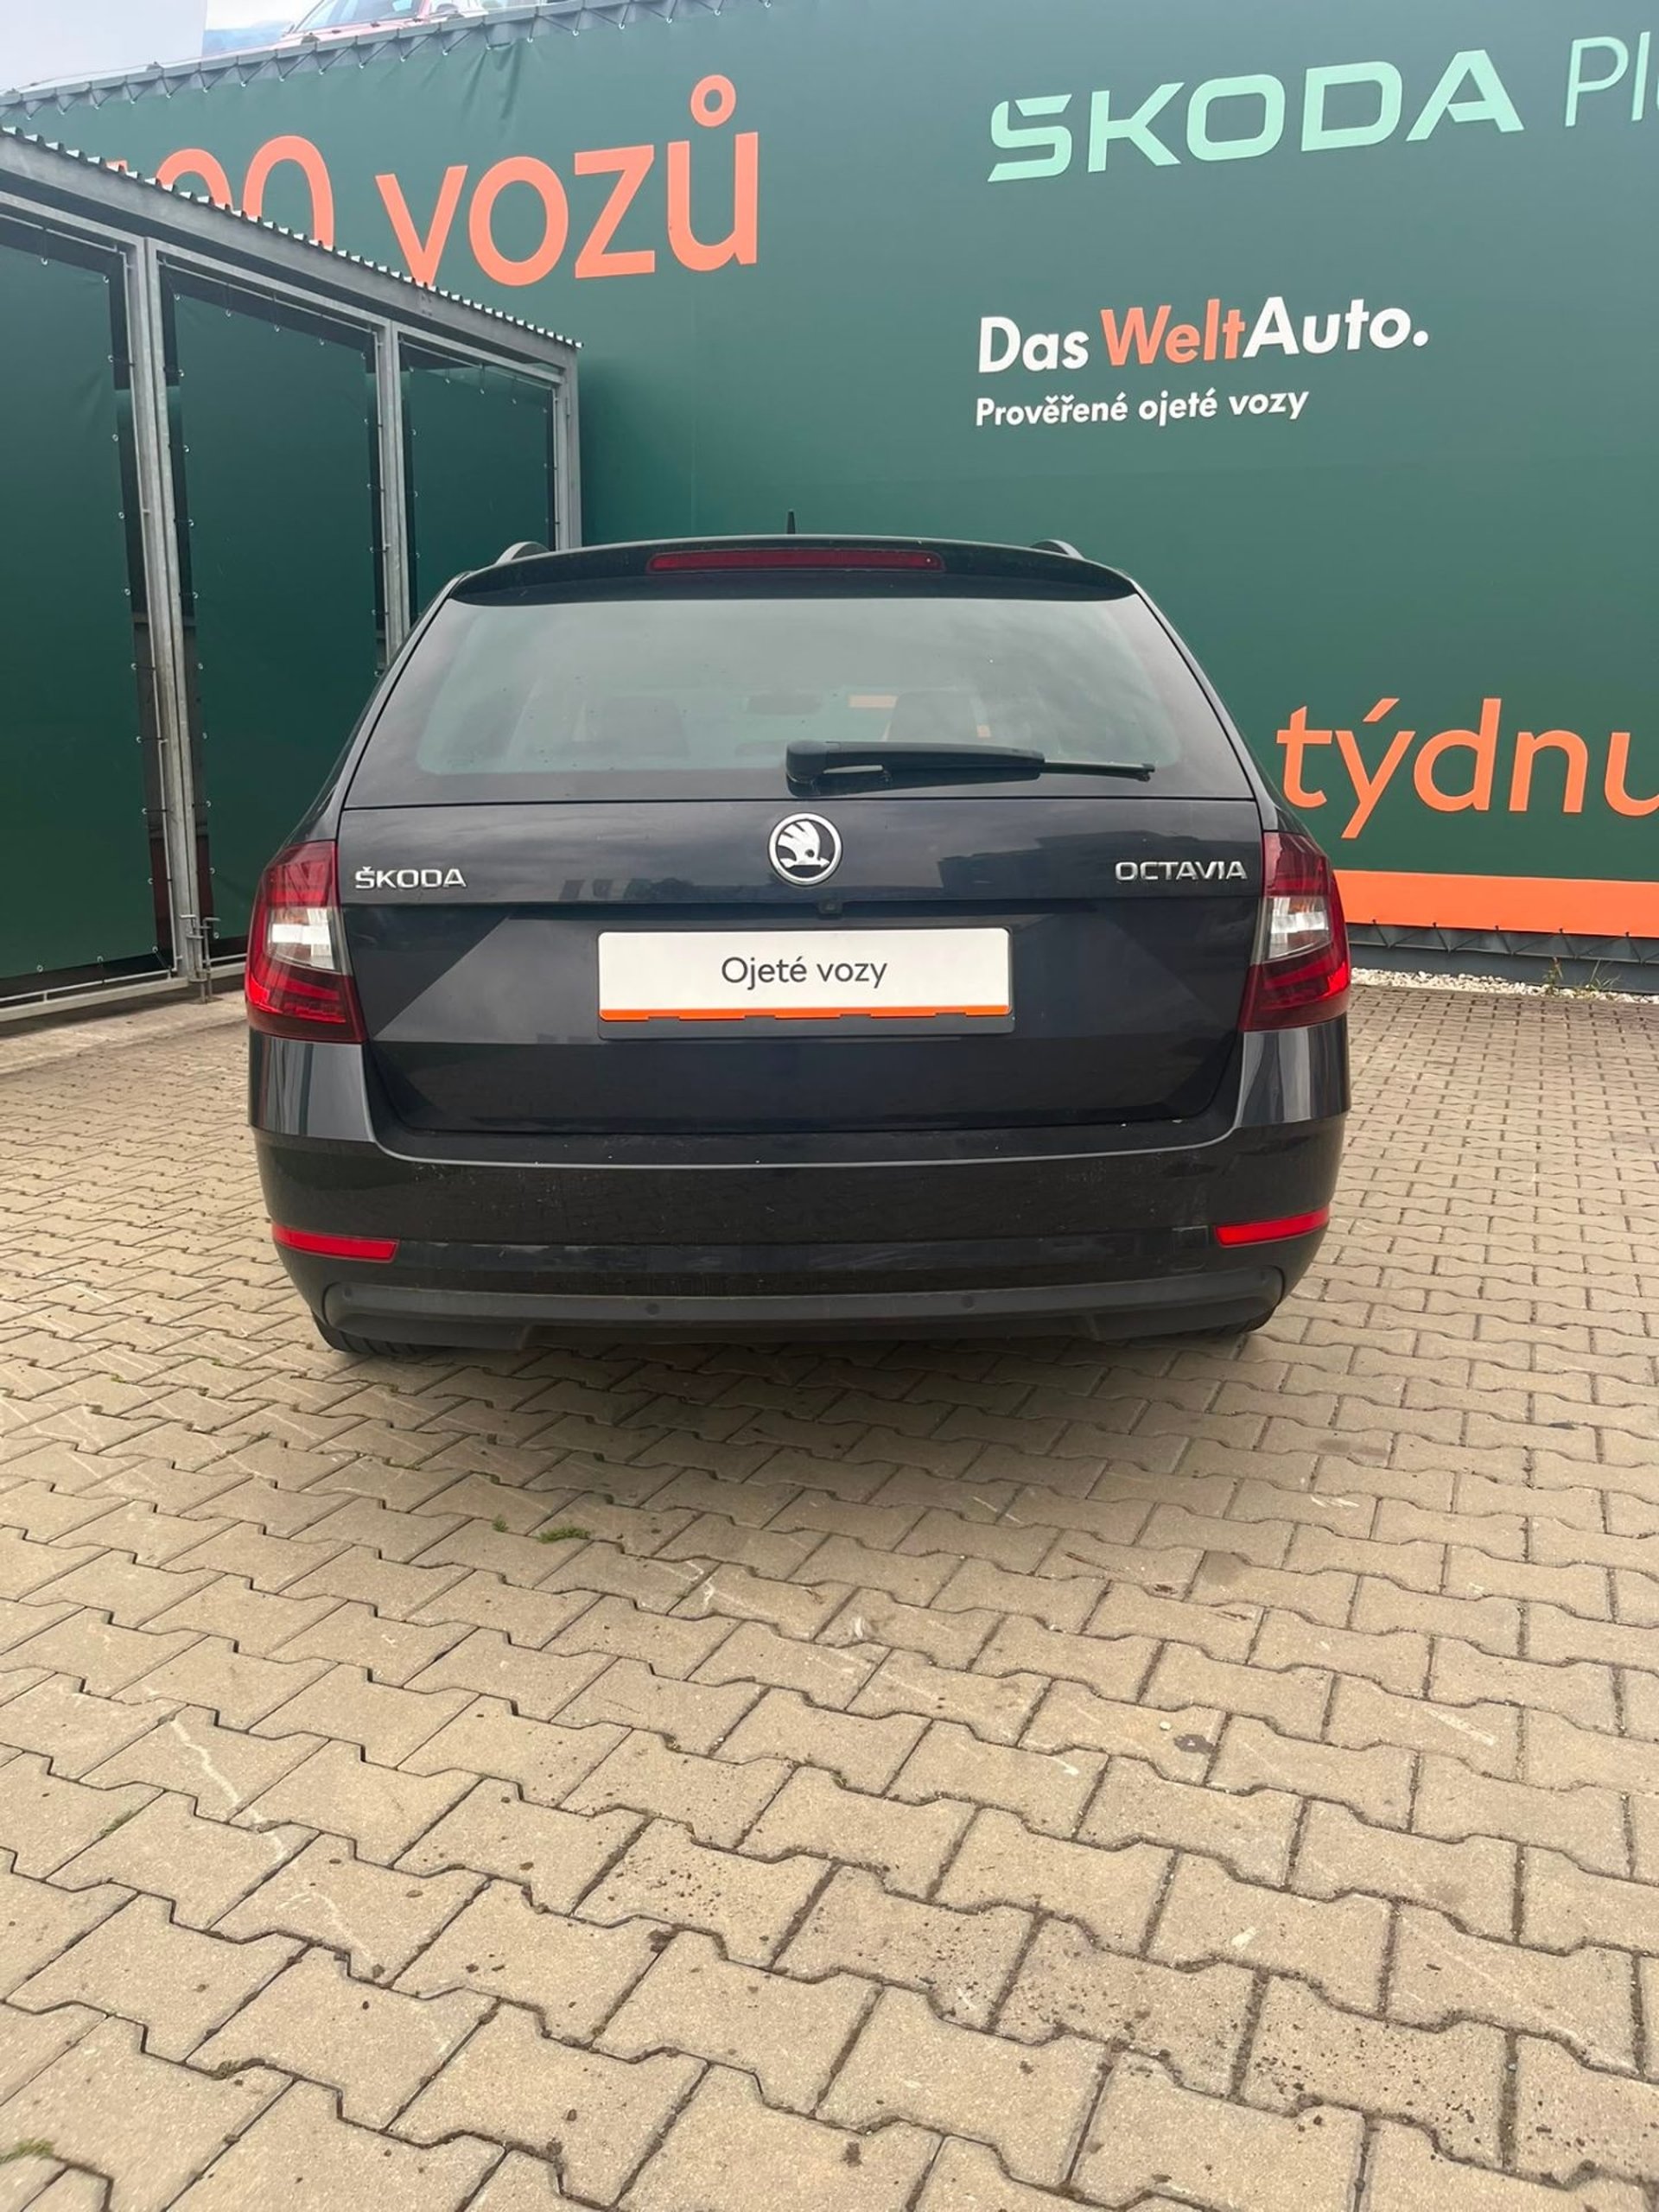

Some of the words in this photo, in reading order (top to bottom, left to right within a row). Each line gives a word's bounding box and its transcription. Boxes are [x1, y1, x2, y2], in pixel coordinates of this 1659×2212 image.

[1564, 30, 1659, 128] Pl
[375, 74, 760, 288] vozů
[977, 315, 1090, 373] Das
[1100, 296, 1429, 366] WeltAuto.
[976, 391, 1128, 427] Prověřené
[1138, 388, 1217, 427] ojeté
[1228, 391, 1310, 420] vozy
[354, 866, 467, 889] ŠKODA
[1115, 861, 1249, 881] OCTAVIA
[721, 956, 808, 992] Ojeté
[817, 963, 888, 988] vozy
